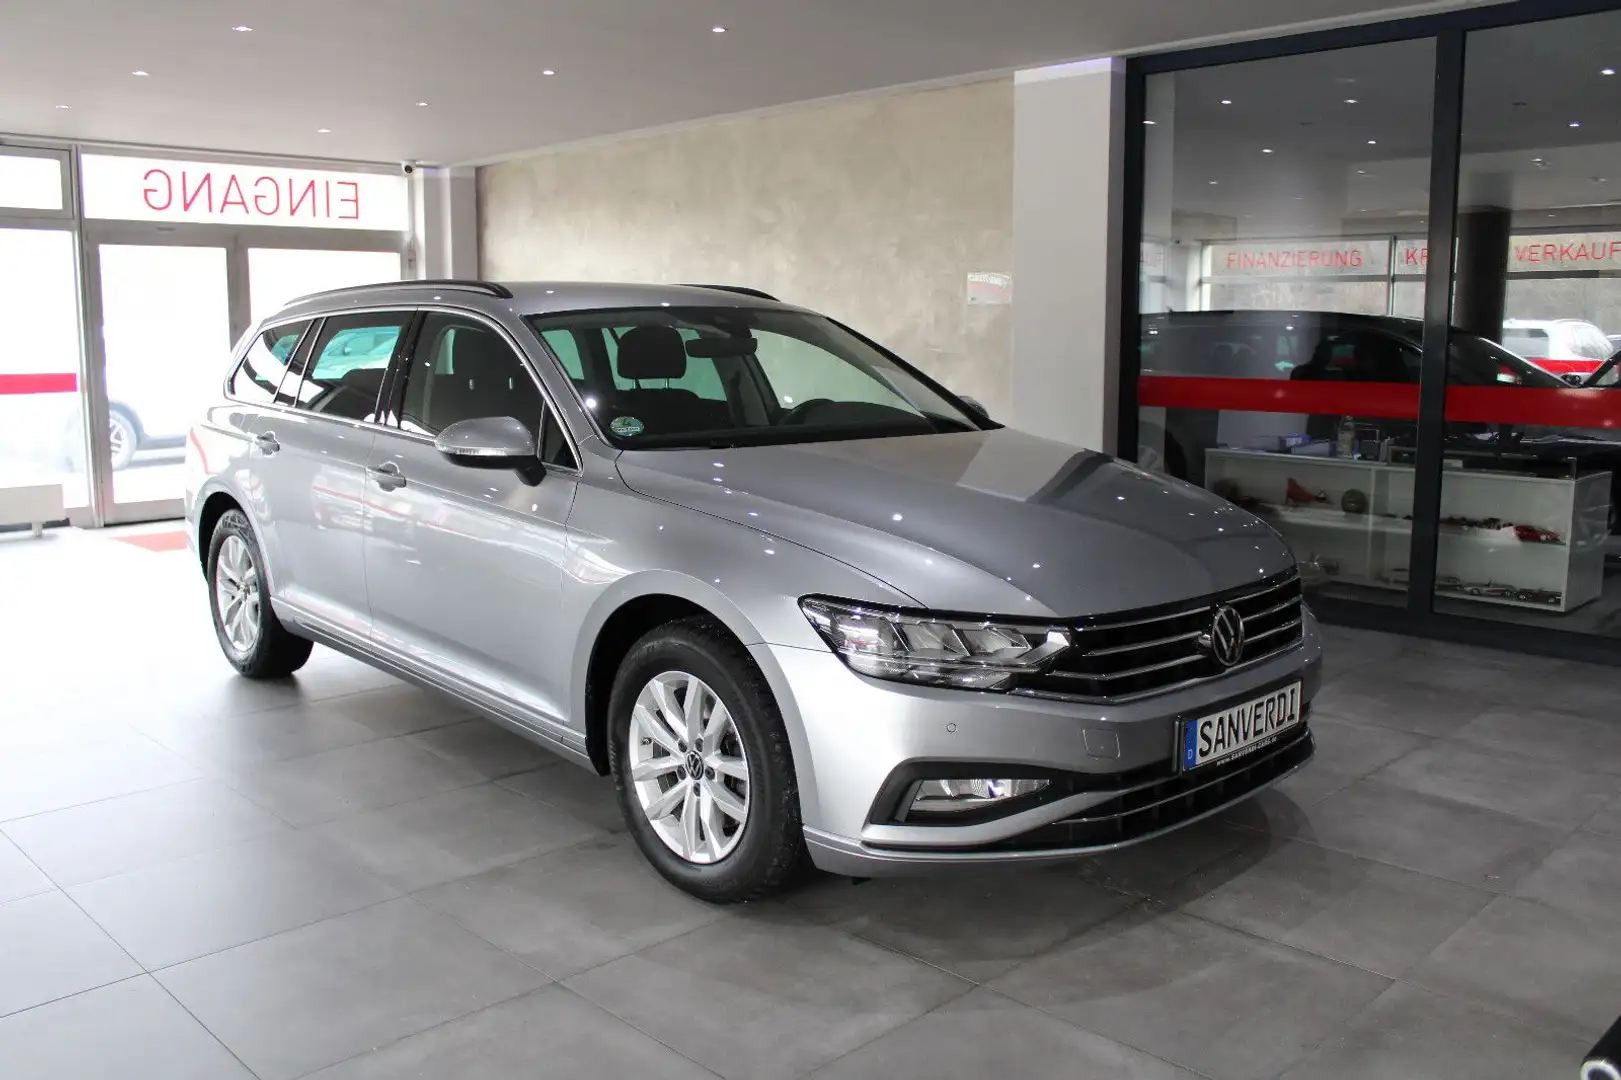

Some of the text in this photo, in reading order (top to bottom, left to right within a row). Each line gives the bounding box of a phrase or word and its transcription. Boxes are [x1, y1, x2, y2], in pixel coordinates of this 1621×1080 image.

[1227, 248, 1363, 269] FINANZIERUNG
[1514, 241, 1621, 263] VERKAUF
[1198, 688, 1296, 757] SANVERDI
[1187, 749, 1193, 760] D
